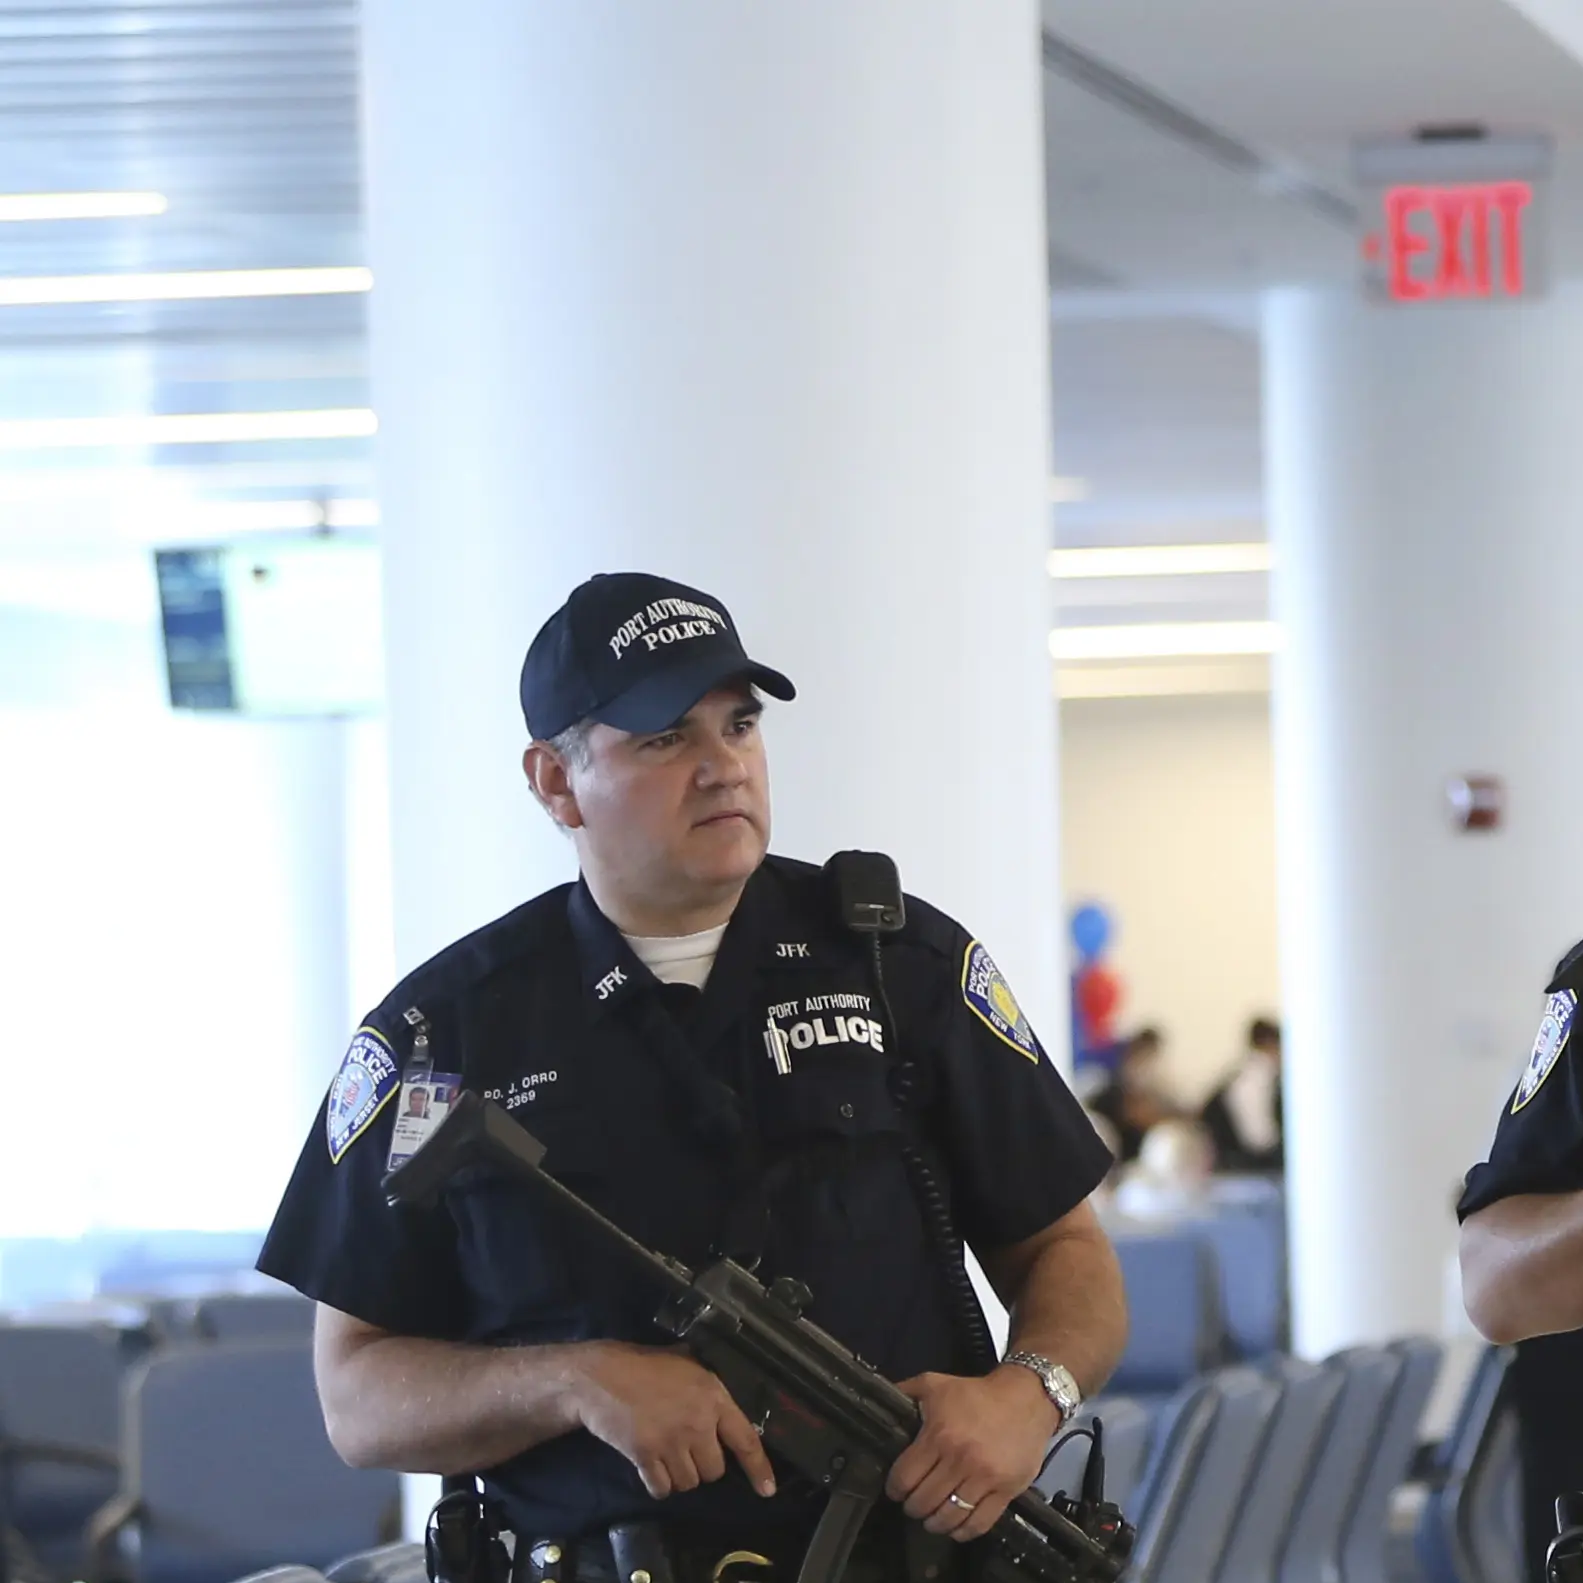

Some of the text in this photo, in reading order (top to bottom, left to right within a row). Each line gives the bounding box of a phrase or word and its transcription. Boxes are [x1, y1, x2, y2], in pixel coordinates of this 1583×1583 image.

[1386, 182, 1532, 301] EXIT
[609, 598, 728, 659] PORT AUTHORITY
[641, 620, 716, 651] POLICE
[776, 943, 811, 958] JFK
[594, 965, 628, 1000] JFK
[768, 993, 871, 1019] PORT AUTHORITY
[763, 1016, 884, 1059] POLICE
[347, 1046, 388, 1085] POLICE
[351, 1093, 379, 1130] JERSEY
